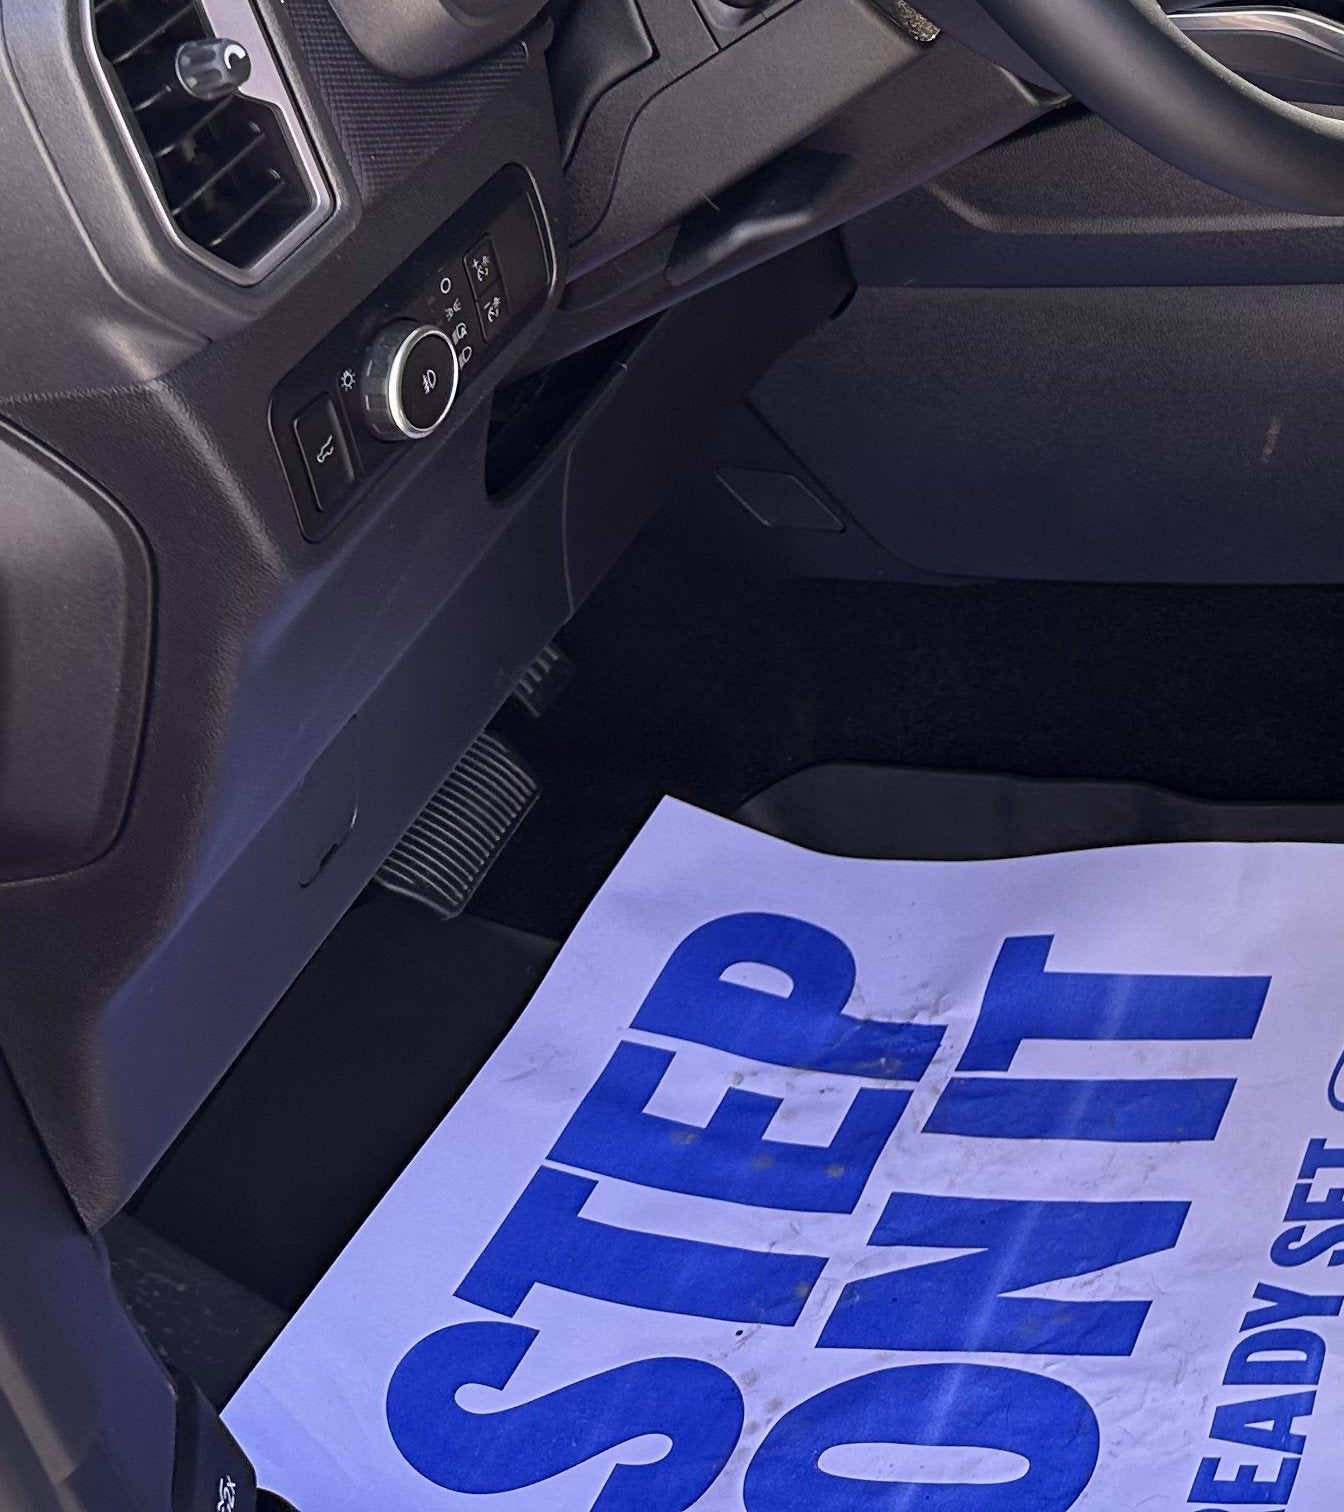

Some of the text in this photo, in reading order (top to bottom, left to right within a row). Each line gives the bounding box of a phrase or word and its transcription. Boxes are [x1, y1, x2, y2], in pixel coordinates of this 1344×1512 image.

[385, 910, 949, 1512] STEP
[742, 933, 1273, 1512] ON IT
